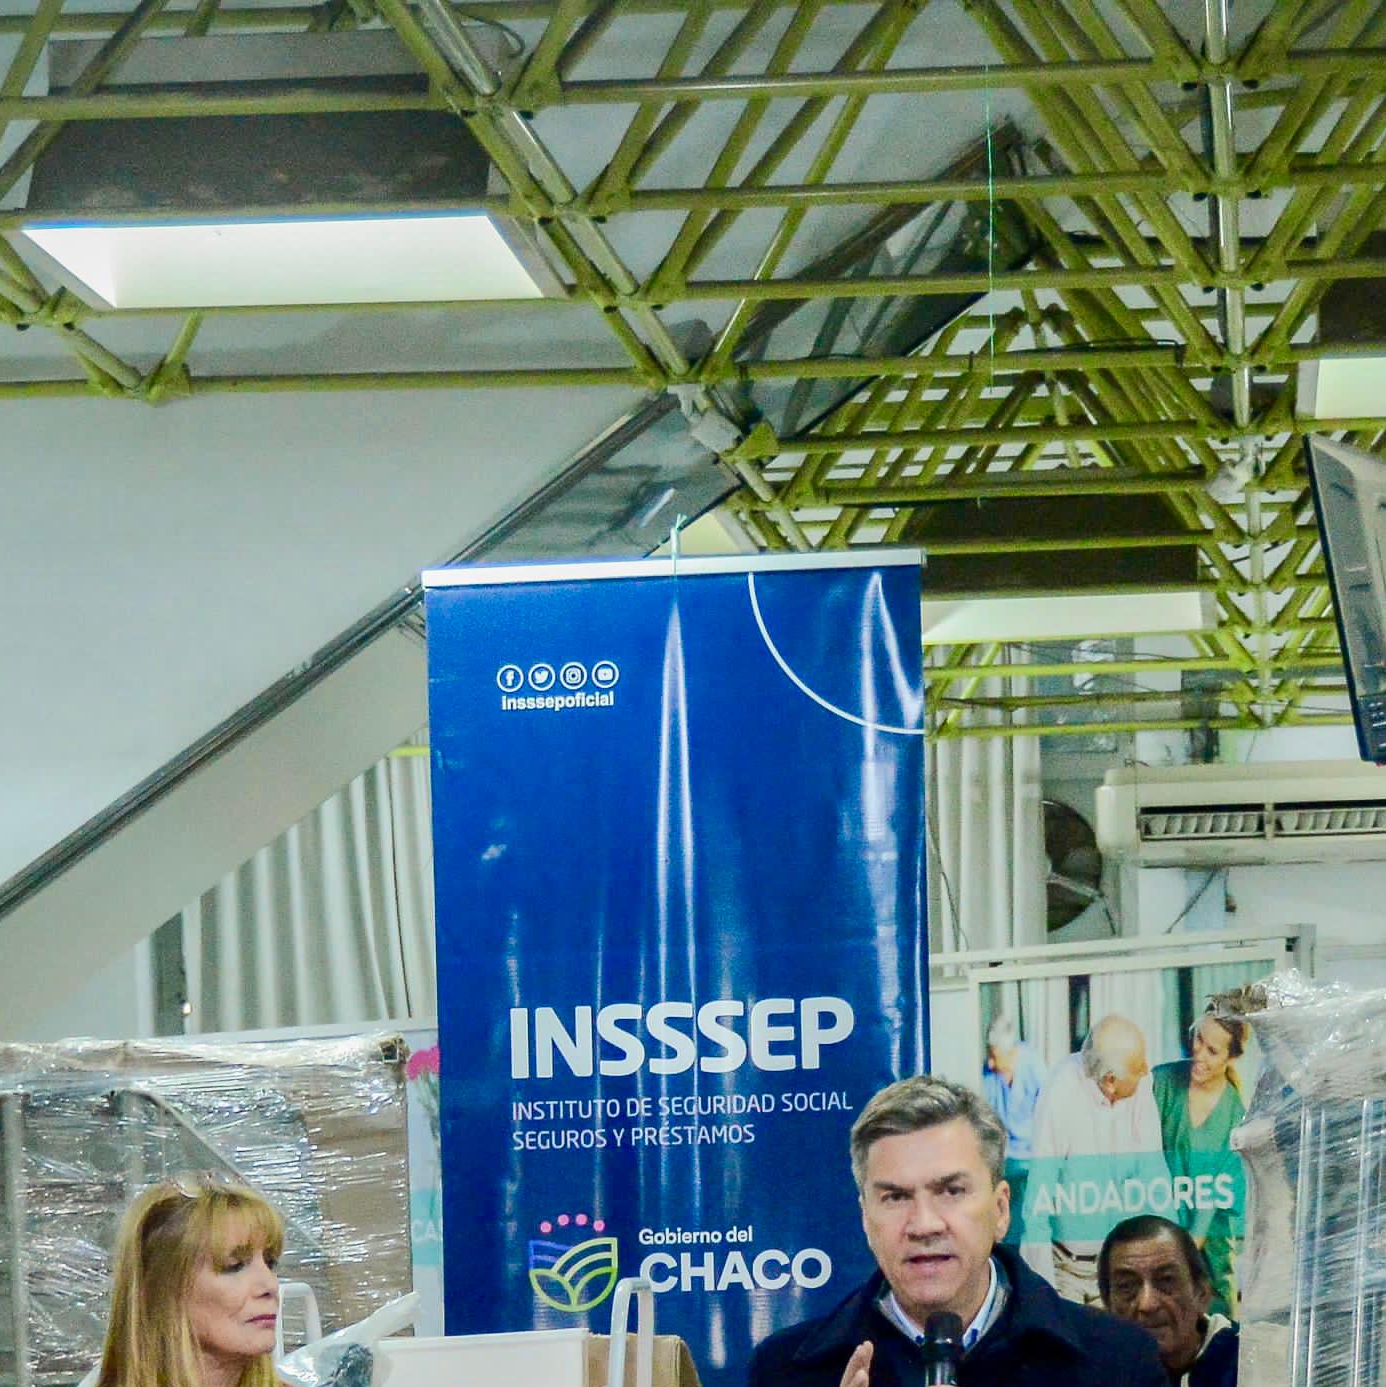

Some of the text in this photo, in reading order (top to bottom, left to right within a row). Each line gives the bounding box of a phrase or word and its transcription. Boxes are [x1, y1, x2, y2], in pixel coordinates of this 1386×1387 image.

[510, 996, 855, 1079] INSSSEP
[513, 1092, 854, 1121] INSTITUTO DE SEGURIDAD SOCIAL
[513, 1121, 755, 1150] SEGUROS Y PRÉSTAMOS
[1032, 1173, 1235, 1216] ANDADORES
[639, 1225, 753, 1245] Gobierno del
[640, 1248, 832, 1293] CHACO
